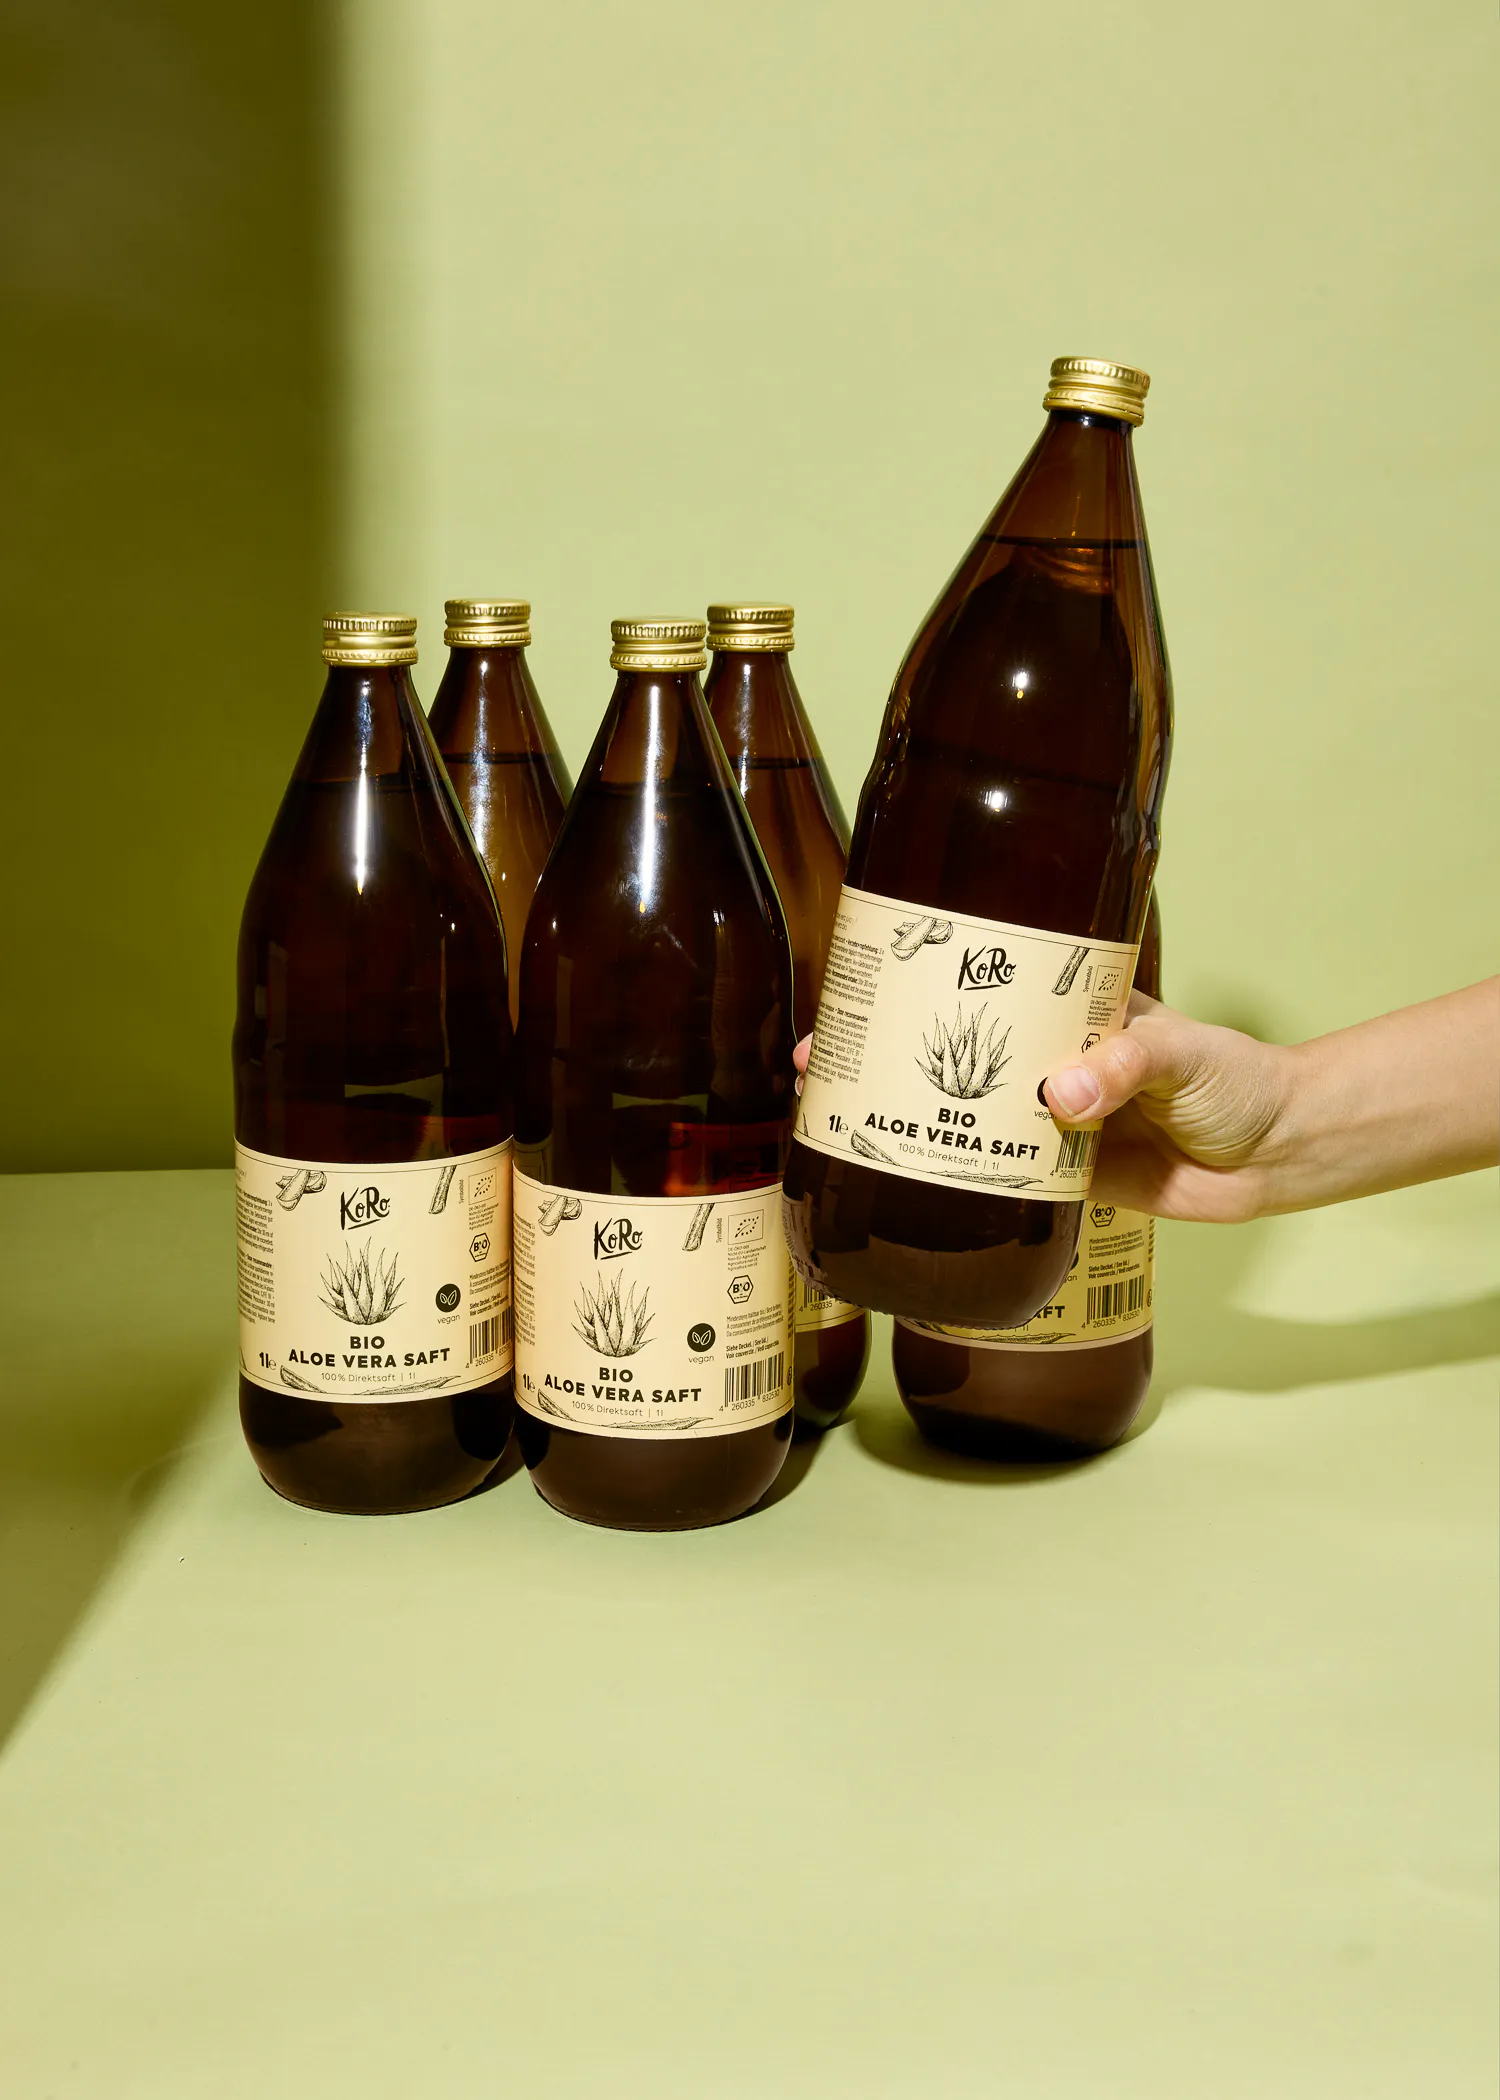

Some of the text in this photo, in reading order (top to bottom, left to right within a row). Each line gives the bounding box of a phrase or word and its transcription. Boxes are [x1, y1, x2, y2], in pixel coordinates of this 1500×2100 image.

[957, 945, 1016, 991] KoRo
[1083, 966, 1093, 992] Symbolbild
[937, 1107, 976, 1128] BIO
[1034, 1110, 1057, 1122] vega
[865, 1112, 1040, 1161] ALOE VERA SAFT
[898, 1142, 925, 1157] 100%
[928, 1150, 978, 1168] Direktsaft
[340, 1186, 390, 1230] KoRo
[594, 1218, 643, 1260] KoRo
[810, 1300, 832, 1312] 260335
[437, 1314, 460, 1324] vegan
[1093, 1317, 1116, 1328] 260335
[1123, 1310, 1139, 1322] 832530
[350, 1336, 385, 1350] BIO
[288, 1347, 450, 1368] ALOE VERA SAFT
[475, 1353, 494, 1367] 260335
[688, 1355, 714, 1364] vegan
[321, 1372, 346, 1382] 100%
[348, 1373, 395, 1382] Direktsaft
[599, 1367, 633, 1382] BIO
[544, 1374, 702, 1402] ALOE VERA SAFT
[572, 1400, 594, 1412] 100%
[596, 1403, 643, 1417] Direktsaft
[732, 1399, 755, 1411] 260335
[762, 1389, 780, 1402] 832530
